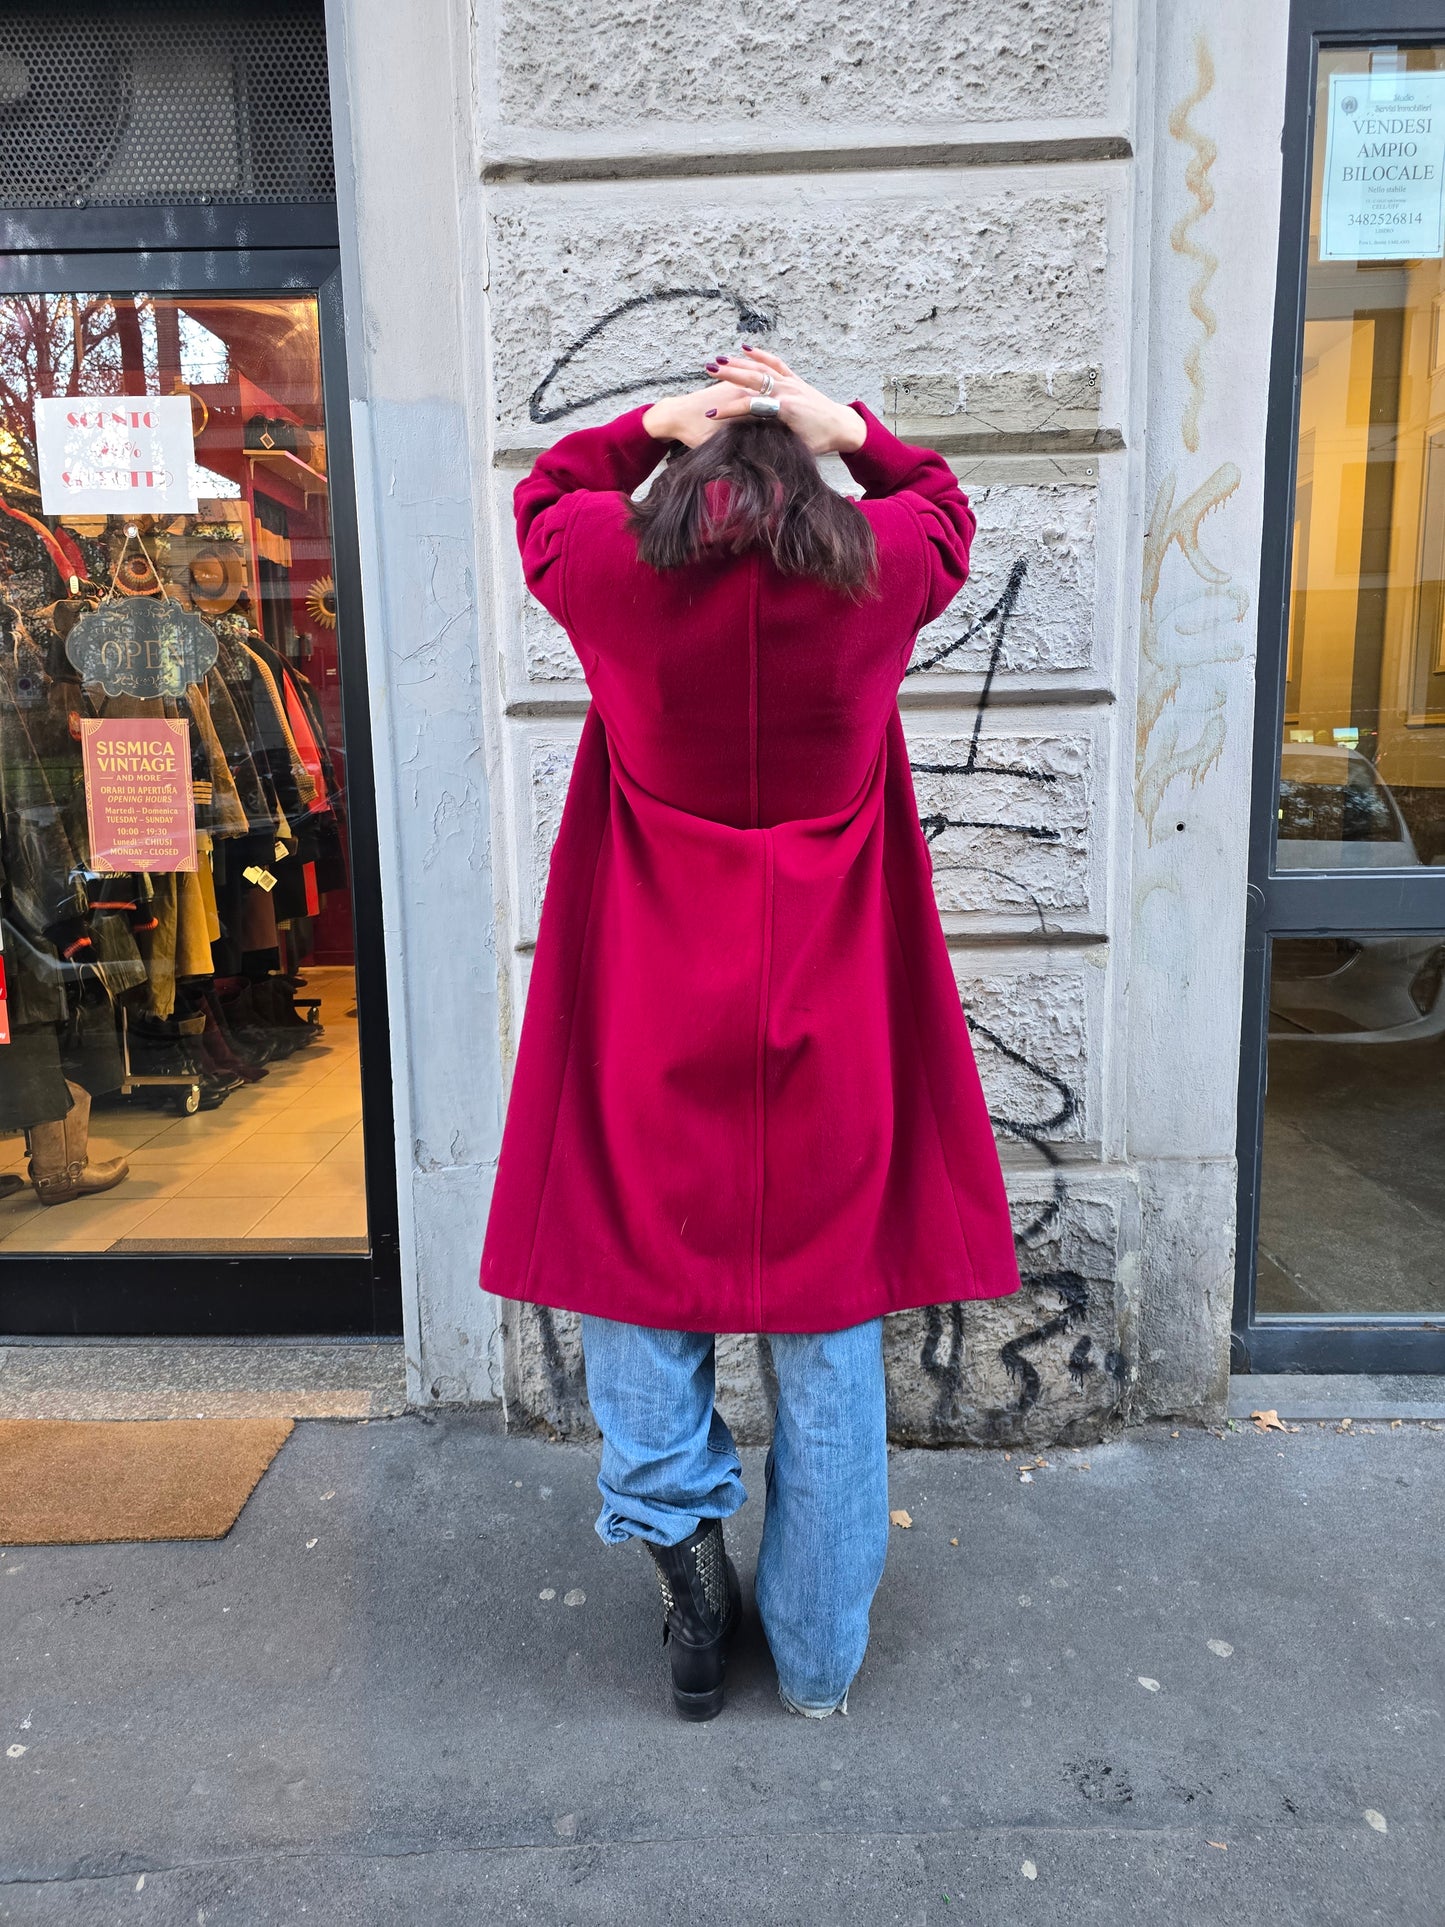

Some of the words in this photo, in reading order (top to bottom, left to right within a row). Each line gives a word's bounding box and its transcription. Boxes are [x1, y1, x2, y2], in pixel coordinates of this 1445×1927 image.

[1352, 118, 1432, 134] VENDESI
[1357, 142, 1417, 158] AMPIO
[1342, 165, 1434, 182] BILOCALE
[1367, 185, 1385, 194] Nello
[1386, 185, 1406, 193] stabile
[1347, 212, 1422, 226] 3482526814
[101, 639, 185, 669] OPEN
[96, 741, 175, 756] SISMICA
[97, 757, 177, 772] VINTAGE
[100, 786, 125, 794] ORARI
[127, 786, 135, 794] DI
[137, 786, 178, 794] APERTURA
[107, 795, 143, 803] OPENING
[144, 795, 172, 803] HOURS
[142, 807, 178, 815] Domenica
[116, 827, 139, 835] 10:00
[146, 827, 167, 835] 19:30
[144, 838, 172, 846] CHIUSI
[110, 848, 143, 856] MONDAY
[149, 848, 179, 856] CLOSED
